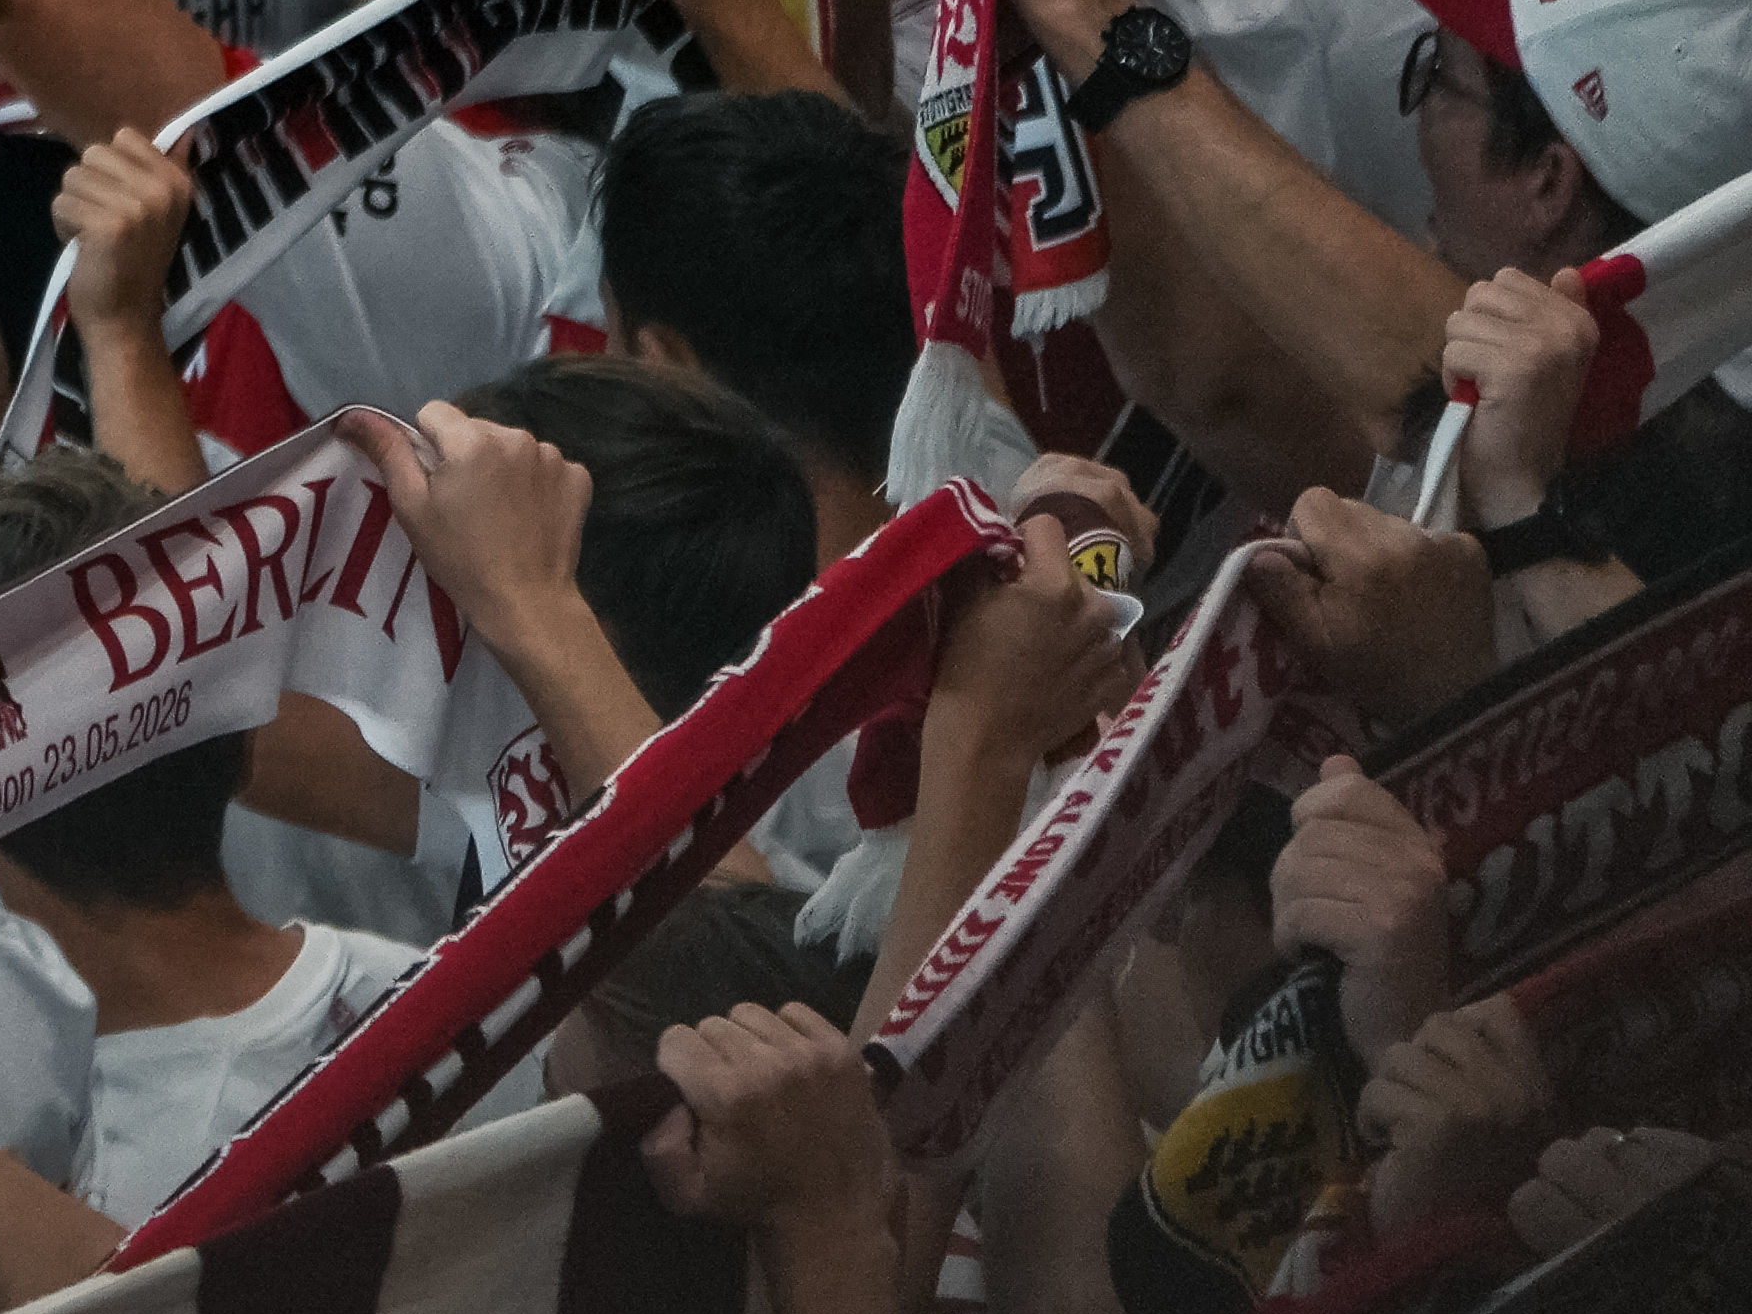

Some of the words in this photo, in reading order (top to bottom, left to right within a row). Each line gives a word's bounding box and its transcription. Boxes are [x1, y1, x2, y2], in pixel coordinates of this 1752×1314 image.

[67, 476, 472, 689] BERLIN
[43, 679, 194, 794] 23.05.2026
[987, 778, 1092, 915] ALONE
